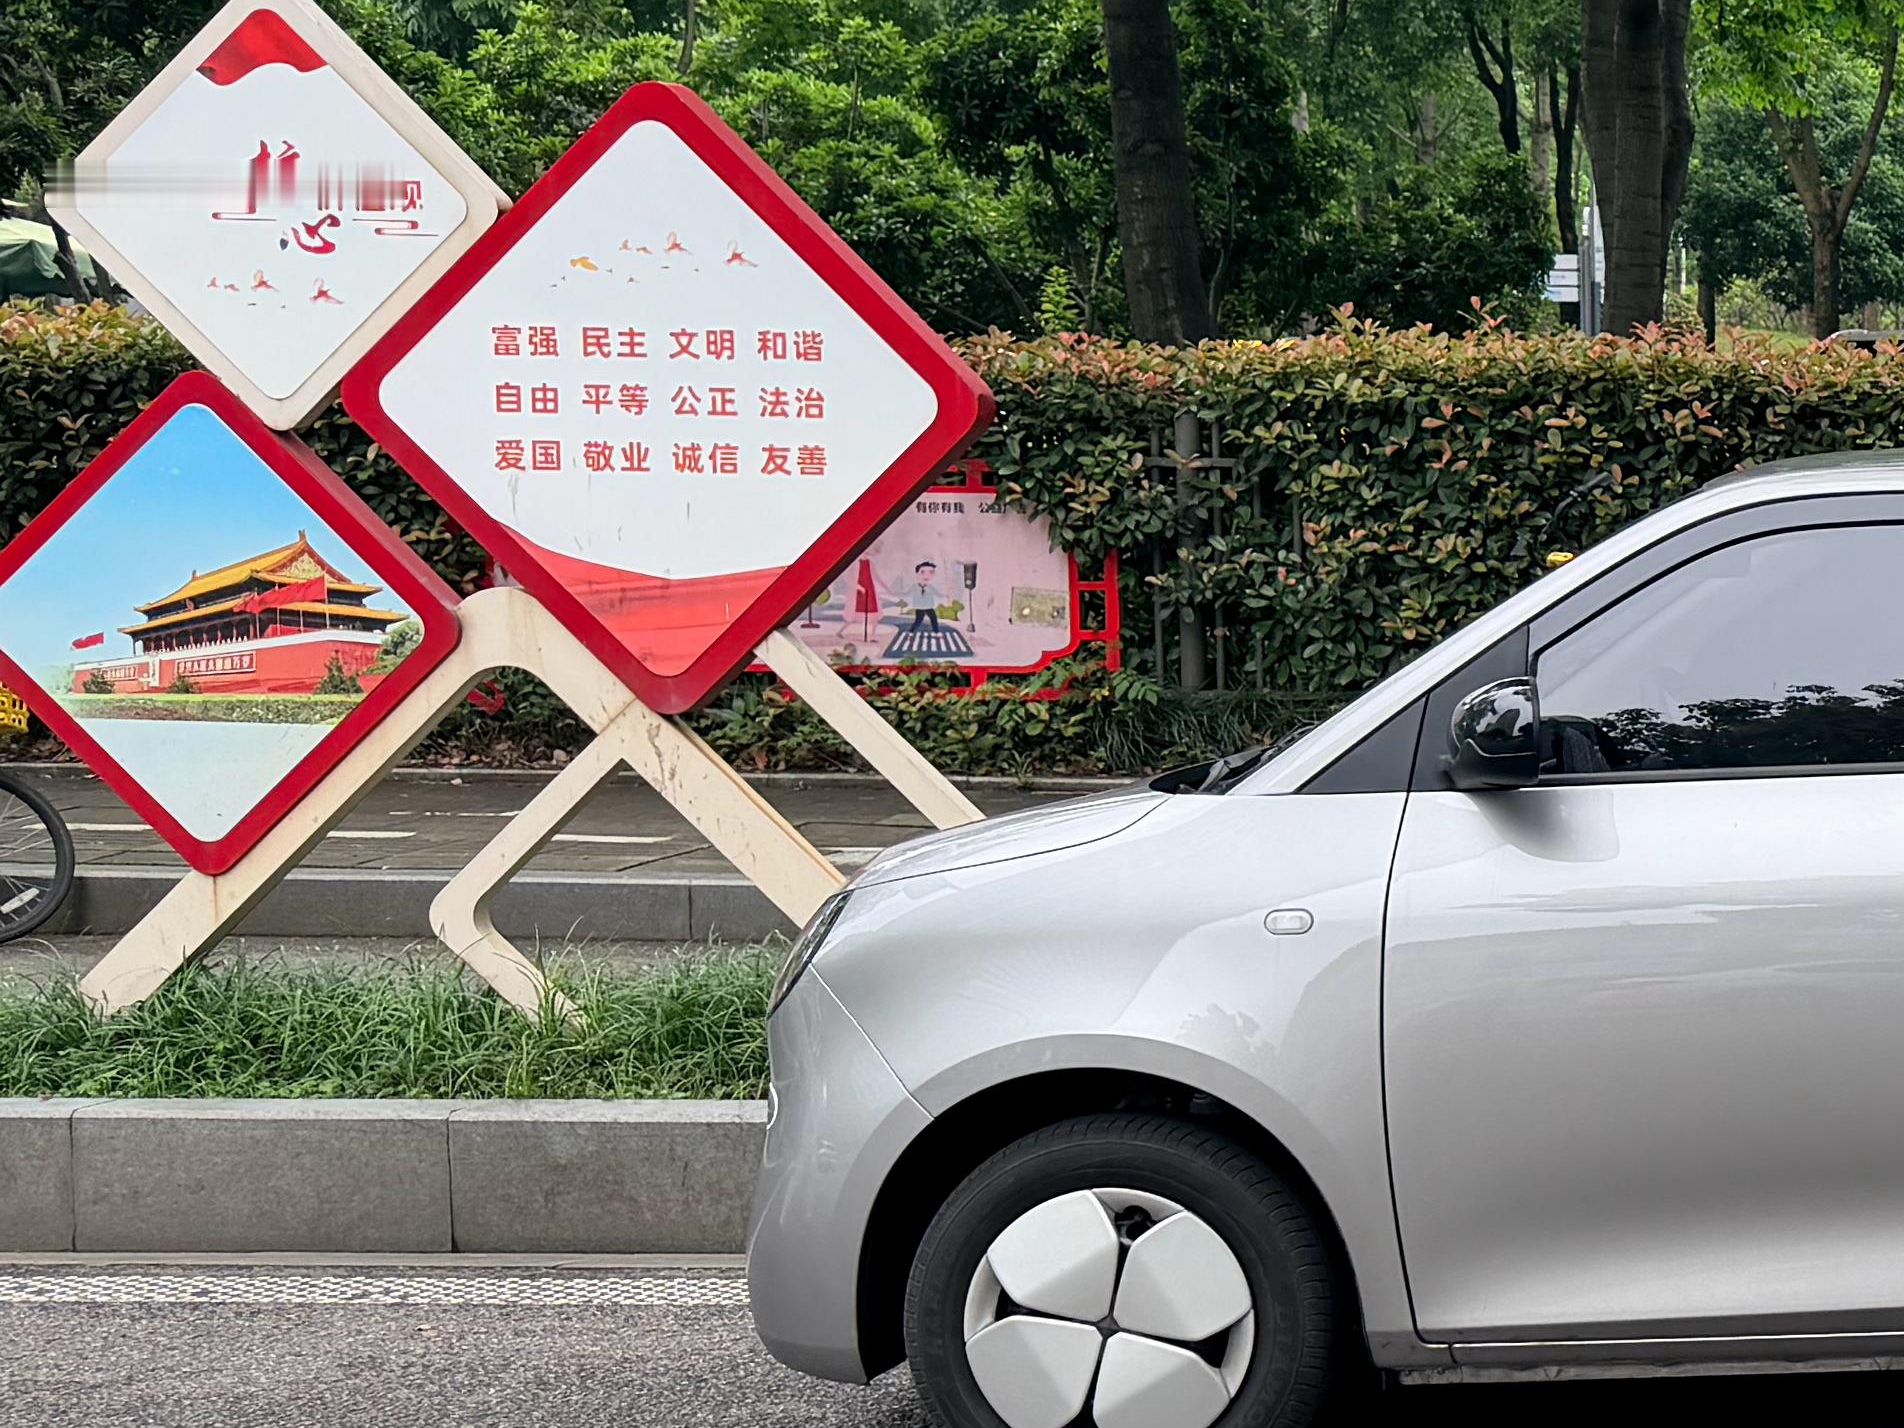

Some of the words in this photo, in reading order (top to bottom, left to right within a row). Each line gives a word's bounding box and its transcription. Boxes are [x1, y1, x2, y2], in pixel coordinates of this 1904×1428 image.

[492, 324, 559, 358] 富强
[582, 327, 648, 359] 民主
[669, 328, 735, 361] 文明
[757, 330, 824, 363] 和谐
[495, 382, 559, 415] 自由
[582, 383, 649, 416] 平等
[670, 385, 739, 418] 公正
[758, 386, 825, 420] 法治
[495, 439, 562, 472] 爱国
[583, 440, 651, 473] 敬业
[672, 441, 740, 475] 诚信
[760, 443, 828, 476] 友善
